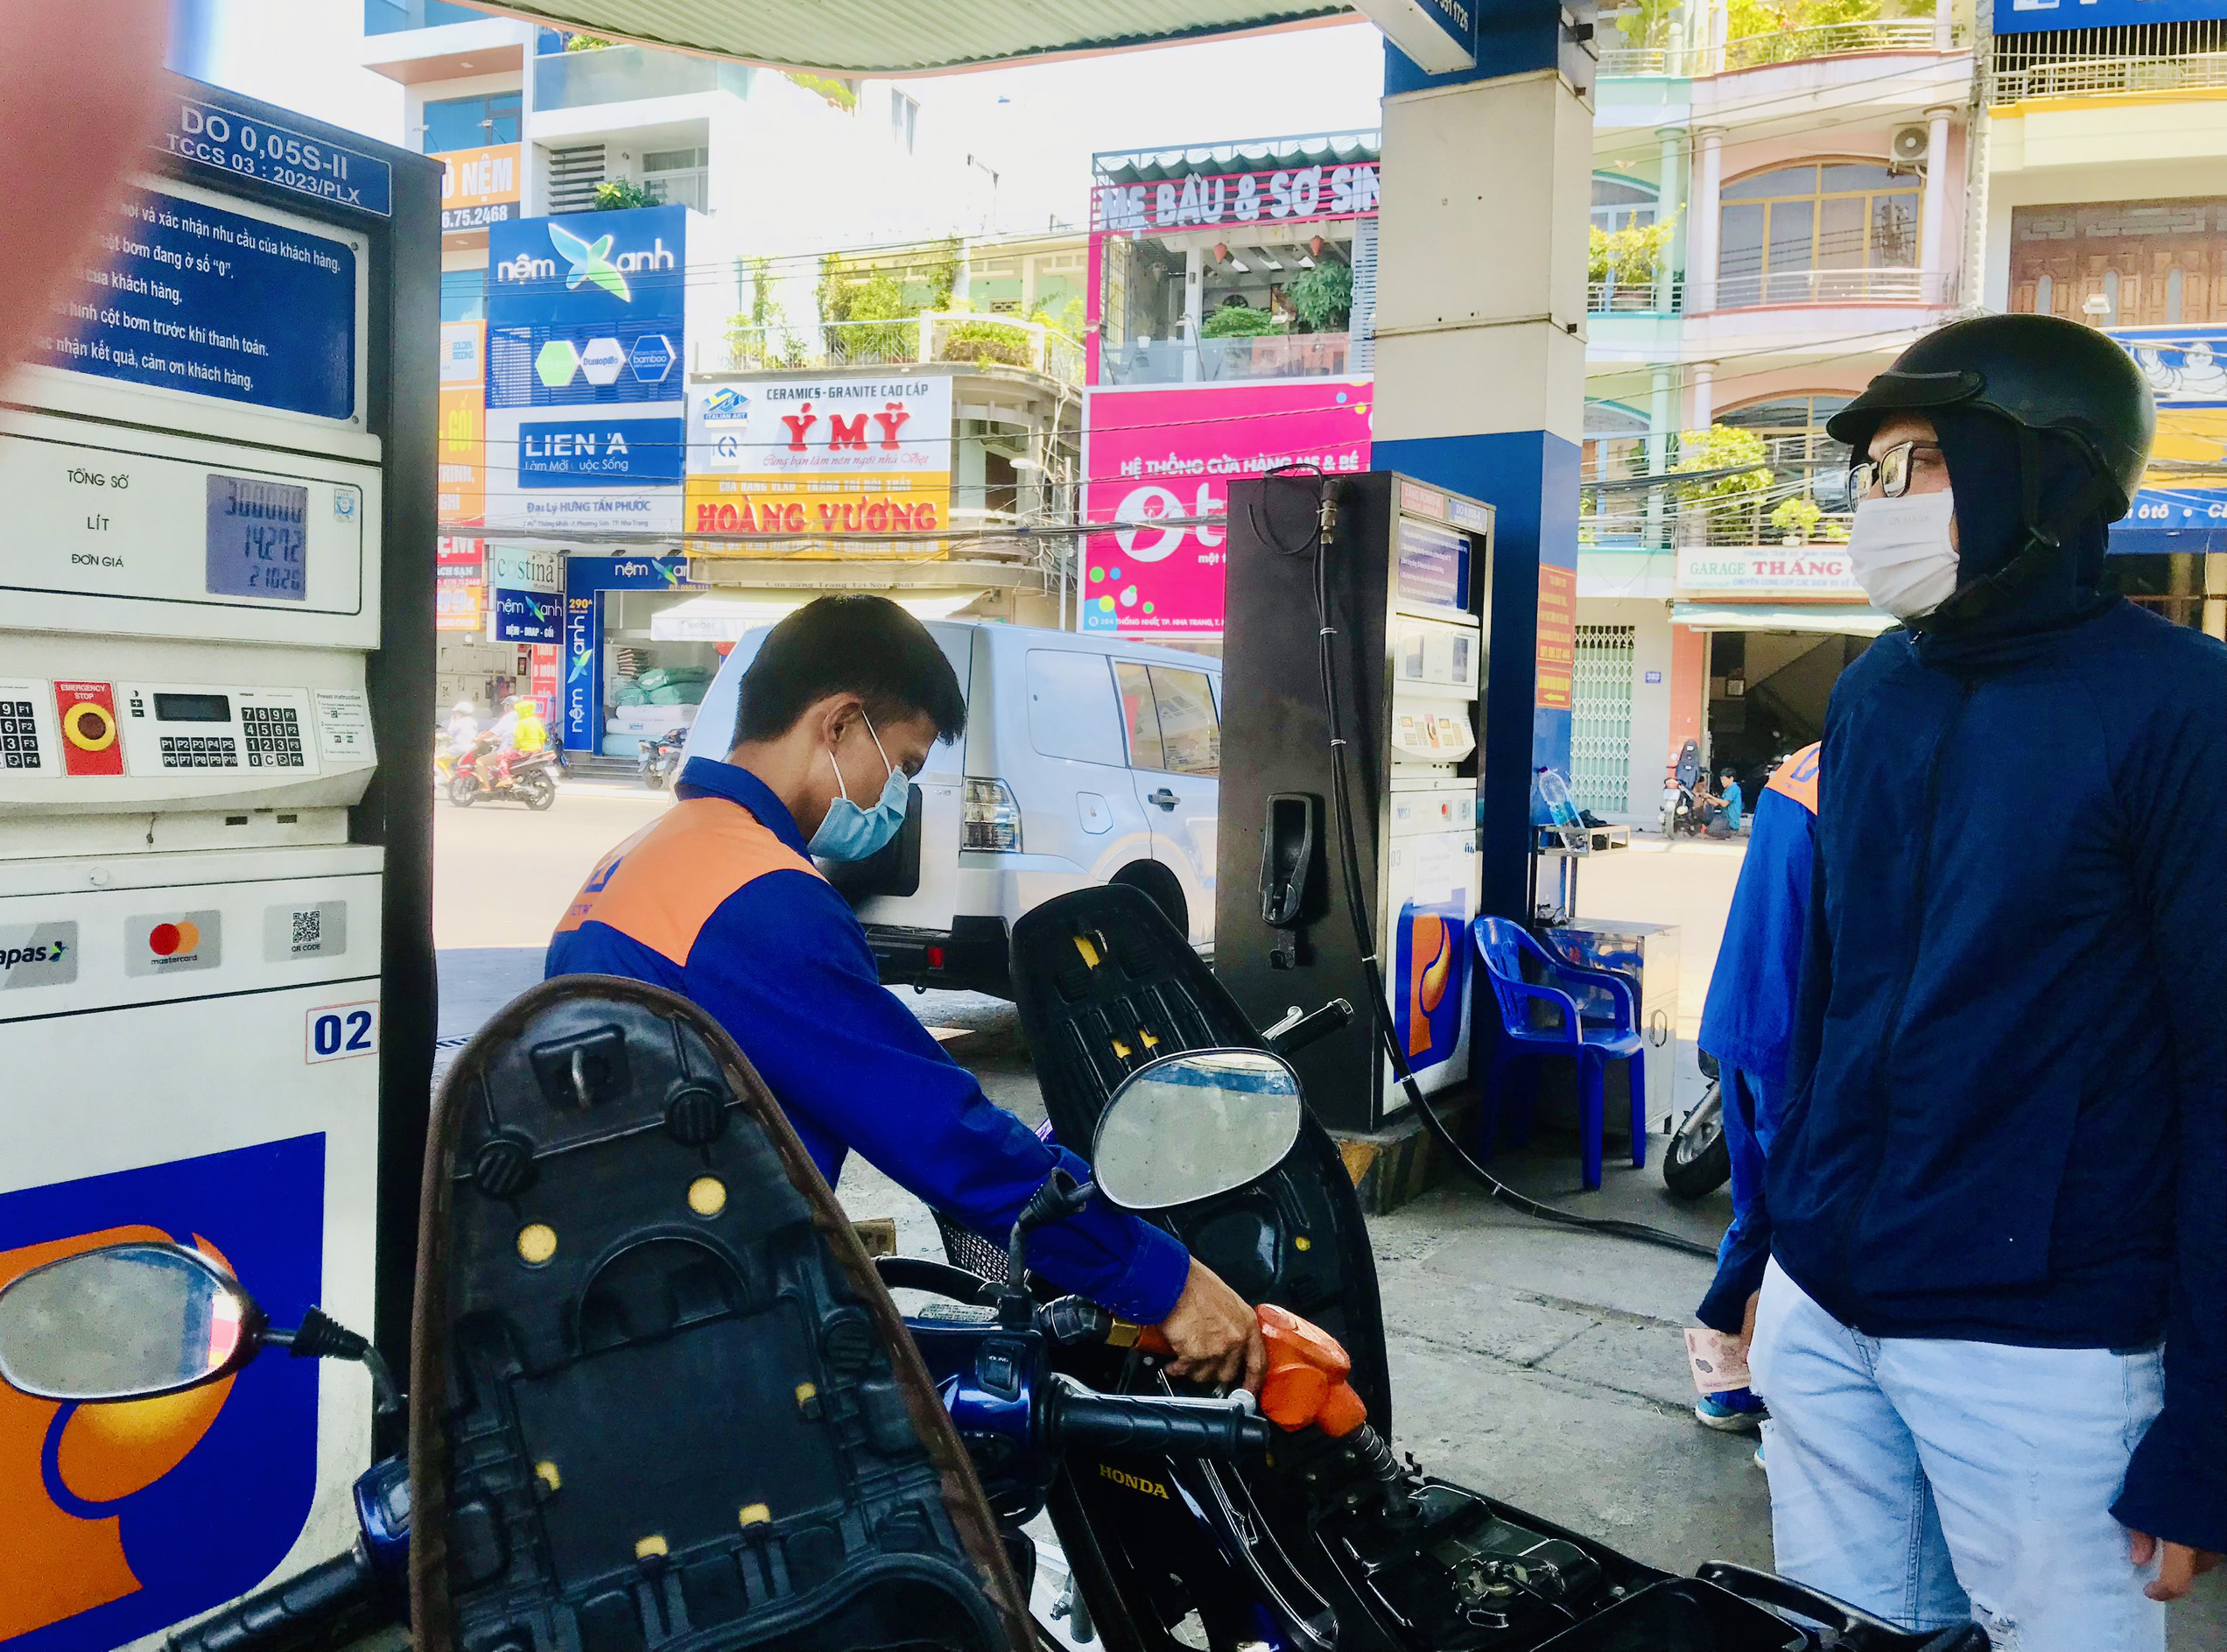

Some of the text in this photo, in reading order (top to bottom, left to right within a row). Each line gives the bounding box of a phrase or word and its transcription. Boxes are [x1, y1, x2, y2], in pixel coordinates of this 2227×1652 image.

[181, 106, 348, 180] DO 0,05S-II
[166, 133, 361, 204] TCCS 03 2023/PLX
[462, 153, 512, 202] NỆM
[1099, 186, 1148, 241] MẸ
[1156, 172, 1226, 227] BẦU
[1234, 174, 1261, 221] &
[1270, 165, 1323, 218] SƠ
[142, 206, 341, 274] và xác nhận nhu cầu của khách hàng.
[123, 237, 210, 272] bơm đang ở số
[497, 253, 556, 285] nệm
[111, 271, 183, 306] khách hàng.
[101, 308, 269, 356] cột bơm trước khi thanh toán.
[57, 337, 88, 358] nhận
[91, 340, 110, 362] kết
[113, 348, 138, 368] quả,
[141, 353, 165, 371] cảm
[169, 360, 185, 375] ơn
[187, 361, 221, 382] khách
[224, 369, 253, 391] hàng.
[633, 354, 667, 364] bamboo
[767, 381, 929, 400] CERAMICS GRANITE CAO CẤP
[781, 402, 818, 451] Ý
[525, 433, 595, 456] LIEN
[550, 458, 568, 471] Mới
[601, 456, 629, 472] Sống
[1121, 456, 1142, 481] HỆ
[1145, 452, 1205, 475] THỐNG
[1206, 453, 1241, 475] CỬA
[1324, 455, 1337, 471] &
[1339, 450, 1359, 471] BÉ
[67, 468, 130, 489] TỔNG SỐ
[559, 502, 590, 512] HƯNG
[615, 496, 651, 512] PHƯỚC
[2139, 503, 2169, 518] ôtô
[696, 495, 938, 532] HOÀNG VƯƠNG
[88, 514, 109, 531] LÍT
[71, 553, 123, 567] ĐƠN GIÁ
[1198, 552, 1220, 566] một
[1690, 558, 1844, 576] GARAGE THÁNG
[615, 561, 649, 578] nệm
[497, 598, 523, 615] nệm
[1116, 615, 1141, 625] THỐNG
[61, 684, 105, 692] EMERGENCY
[2, 703, 30, 715] 9 F1
[244, 710, 251, 720] 7
[260, 710, 266, 720] 8
[273, 710, 280, 720] 9
[568, 687, 585, 733] nệm
[4, 721, 33, 733] 6 F2
[247, 726, 254, 735] 4
[262, 726, 269, 735] 5
[276, 726, 282, 735] 6
[6, 737, 35, 749] 3 F3
[162, 741, 234, 749] P1 P2 P3 P4 P5
[249, 741, 256, 750] 1
[263, 741, 271, 750] 2
[278, 741, 285, 750] 3
[26, 756, 38, 765] F4
[164, 756, 237, 765] P6 P7 P8 P9 P10
[251, 756, 258, 765] 0
[265, 756, 273, 765] C
[302, 943, 321, 952] CODE
[151, 955, 198, 965] mastercard
[314, 1010, 372, 1055] 02
[1099, 1464, 1170, 1500] HONDA
